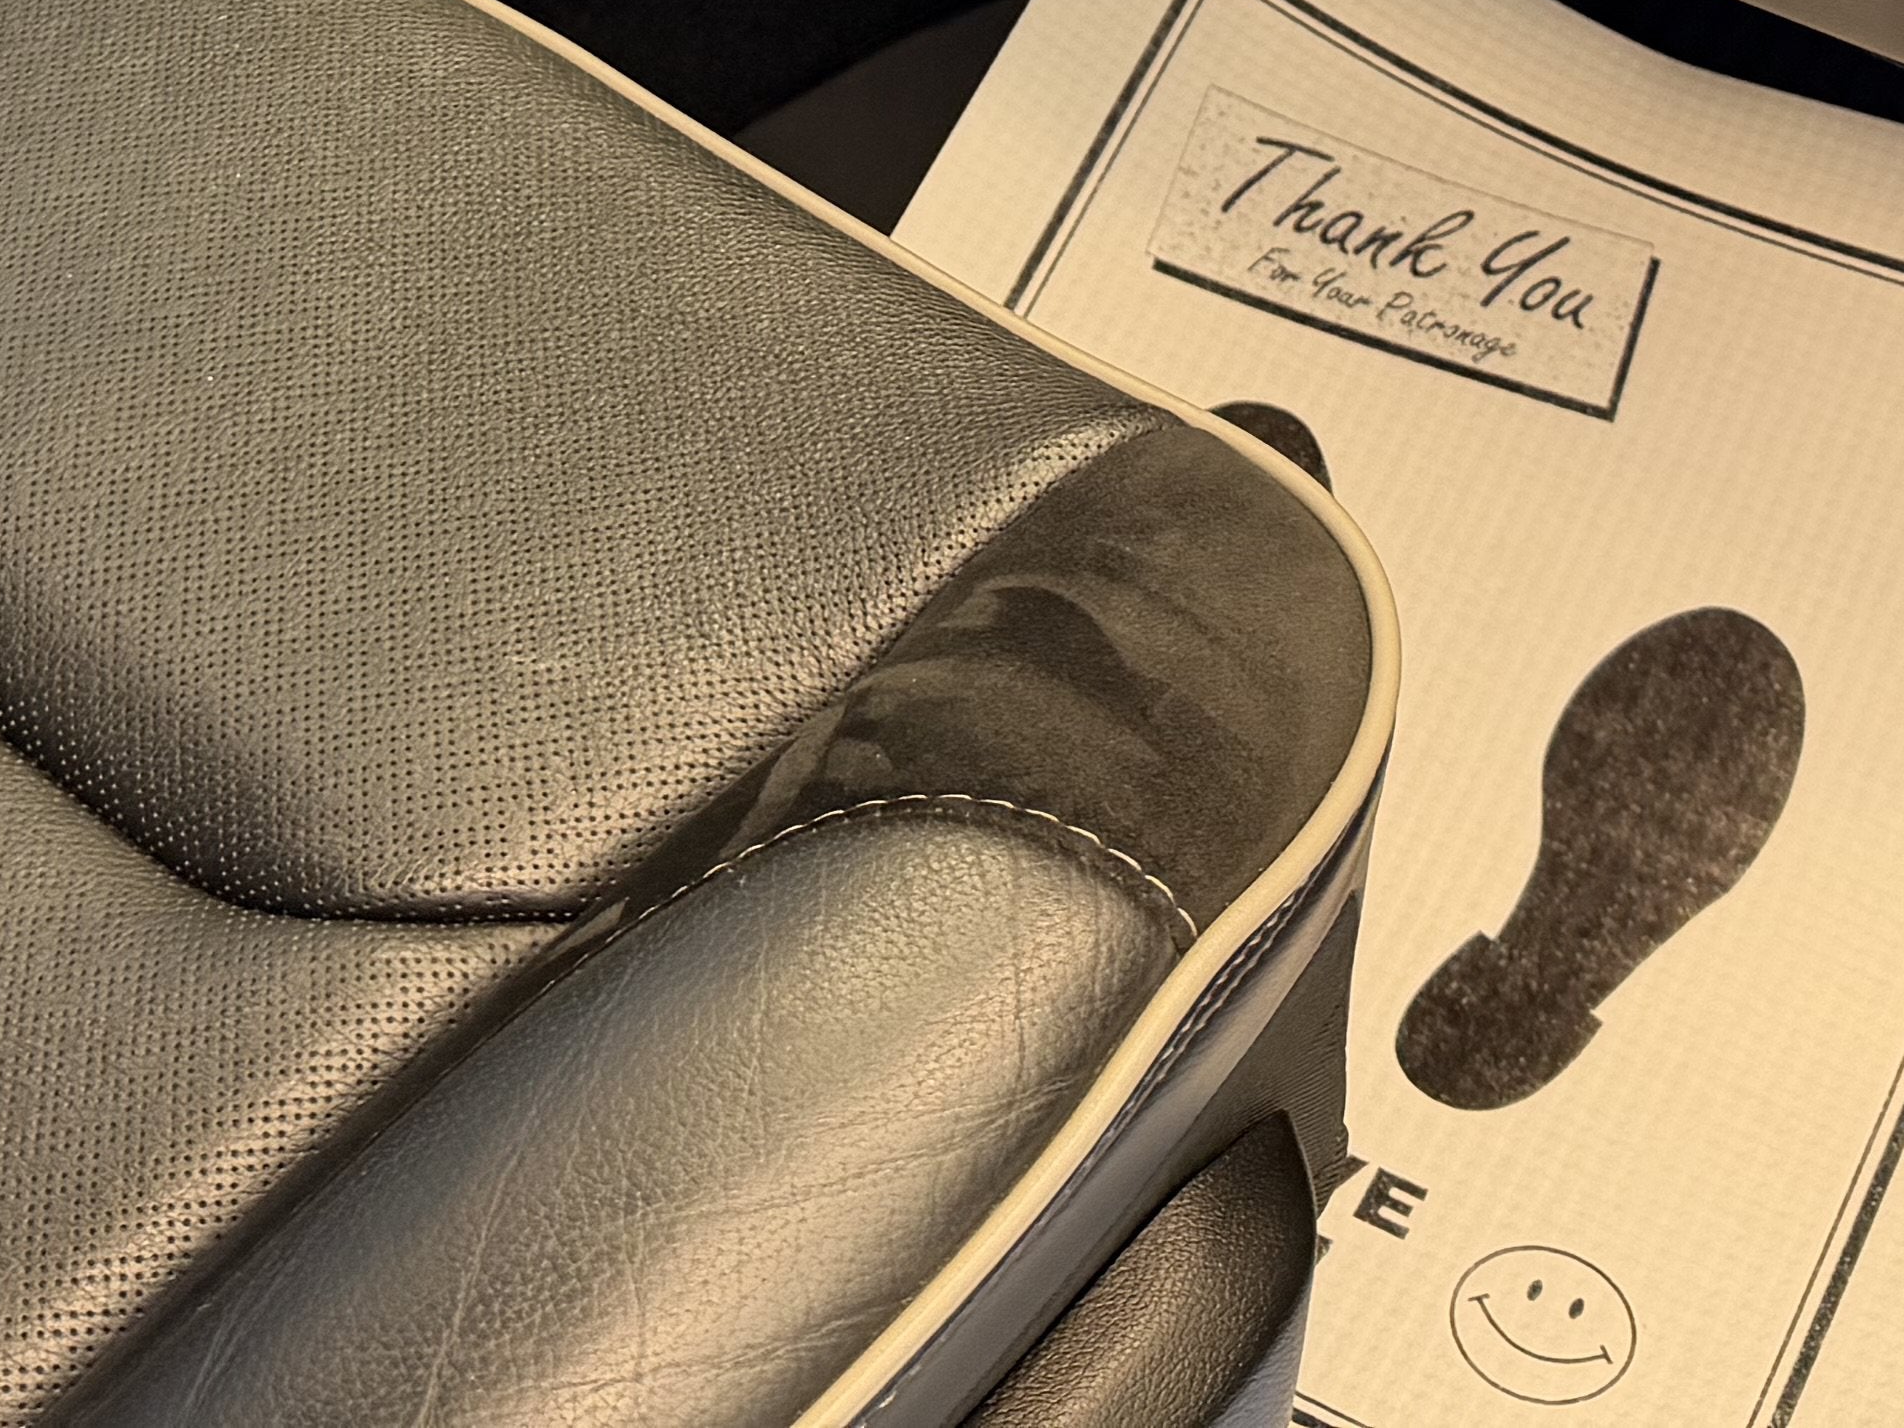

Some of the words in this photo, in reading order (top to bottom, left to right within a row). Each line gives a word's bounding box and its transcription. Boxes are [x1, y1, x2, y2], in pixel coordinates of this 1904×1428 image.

[1220, 135, 1476, 279] Thank
[1481, 229, 1599, 330] You
[1376, 291, 1520, 363] Patronage
